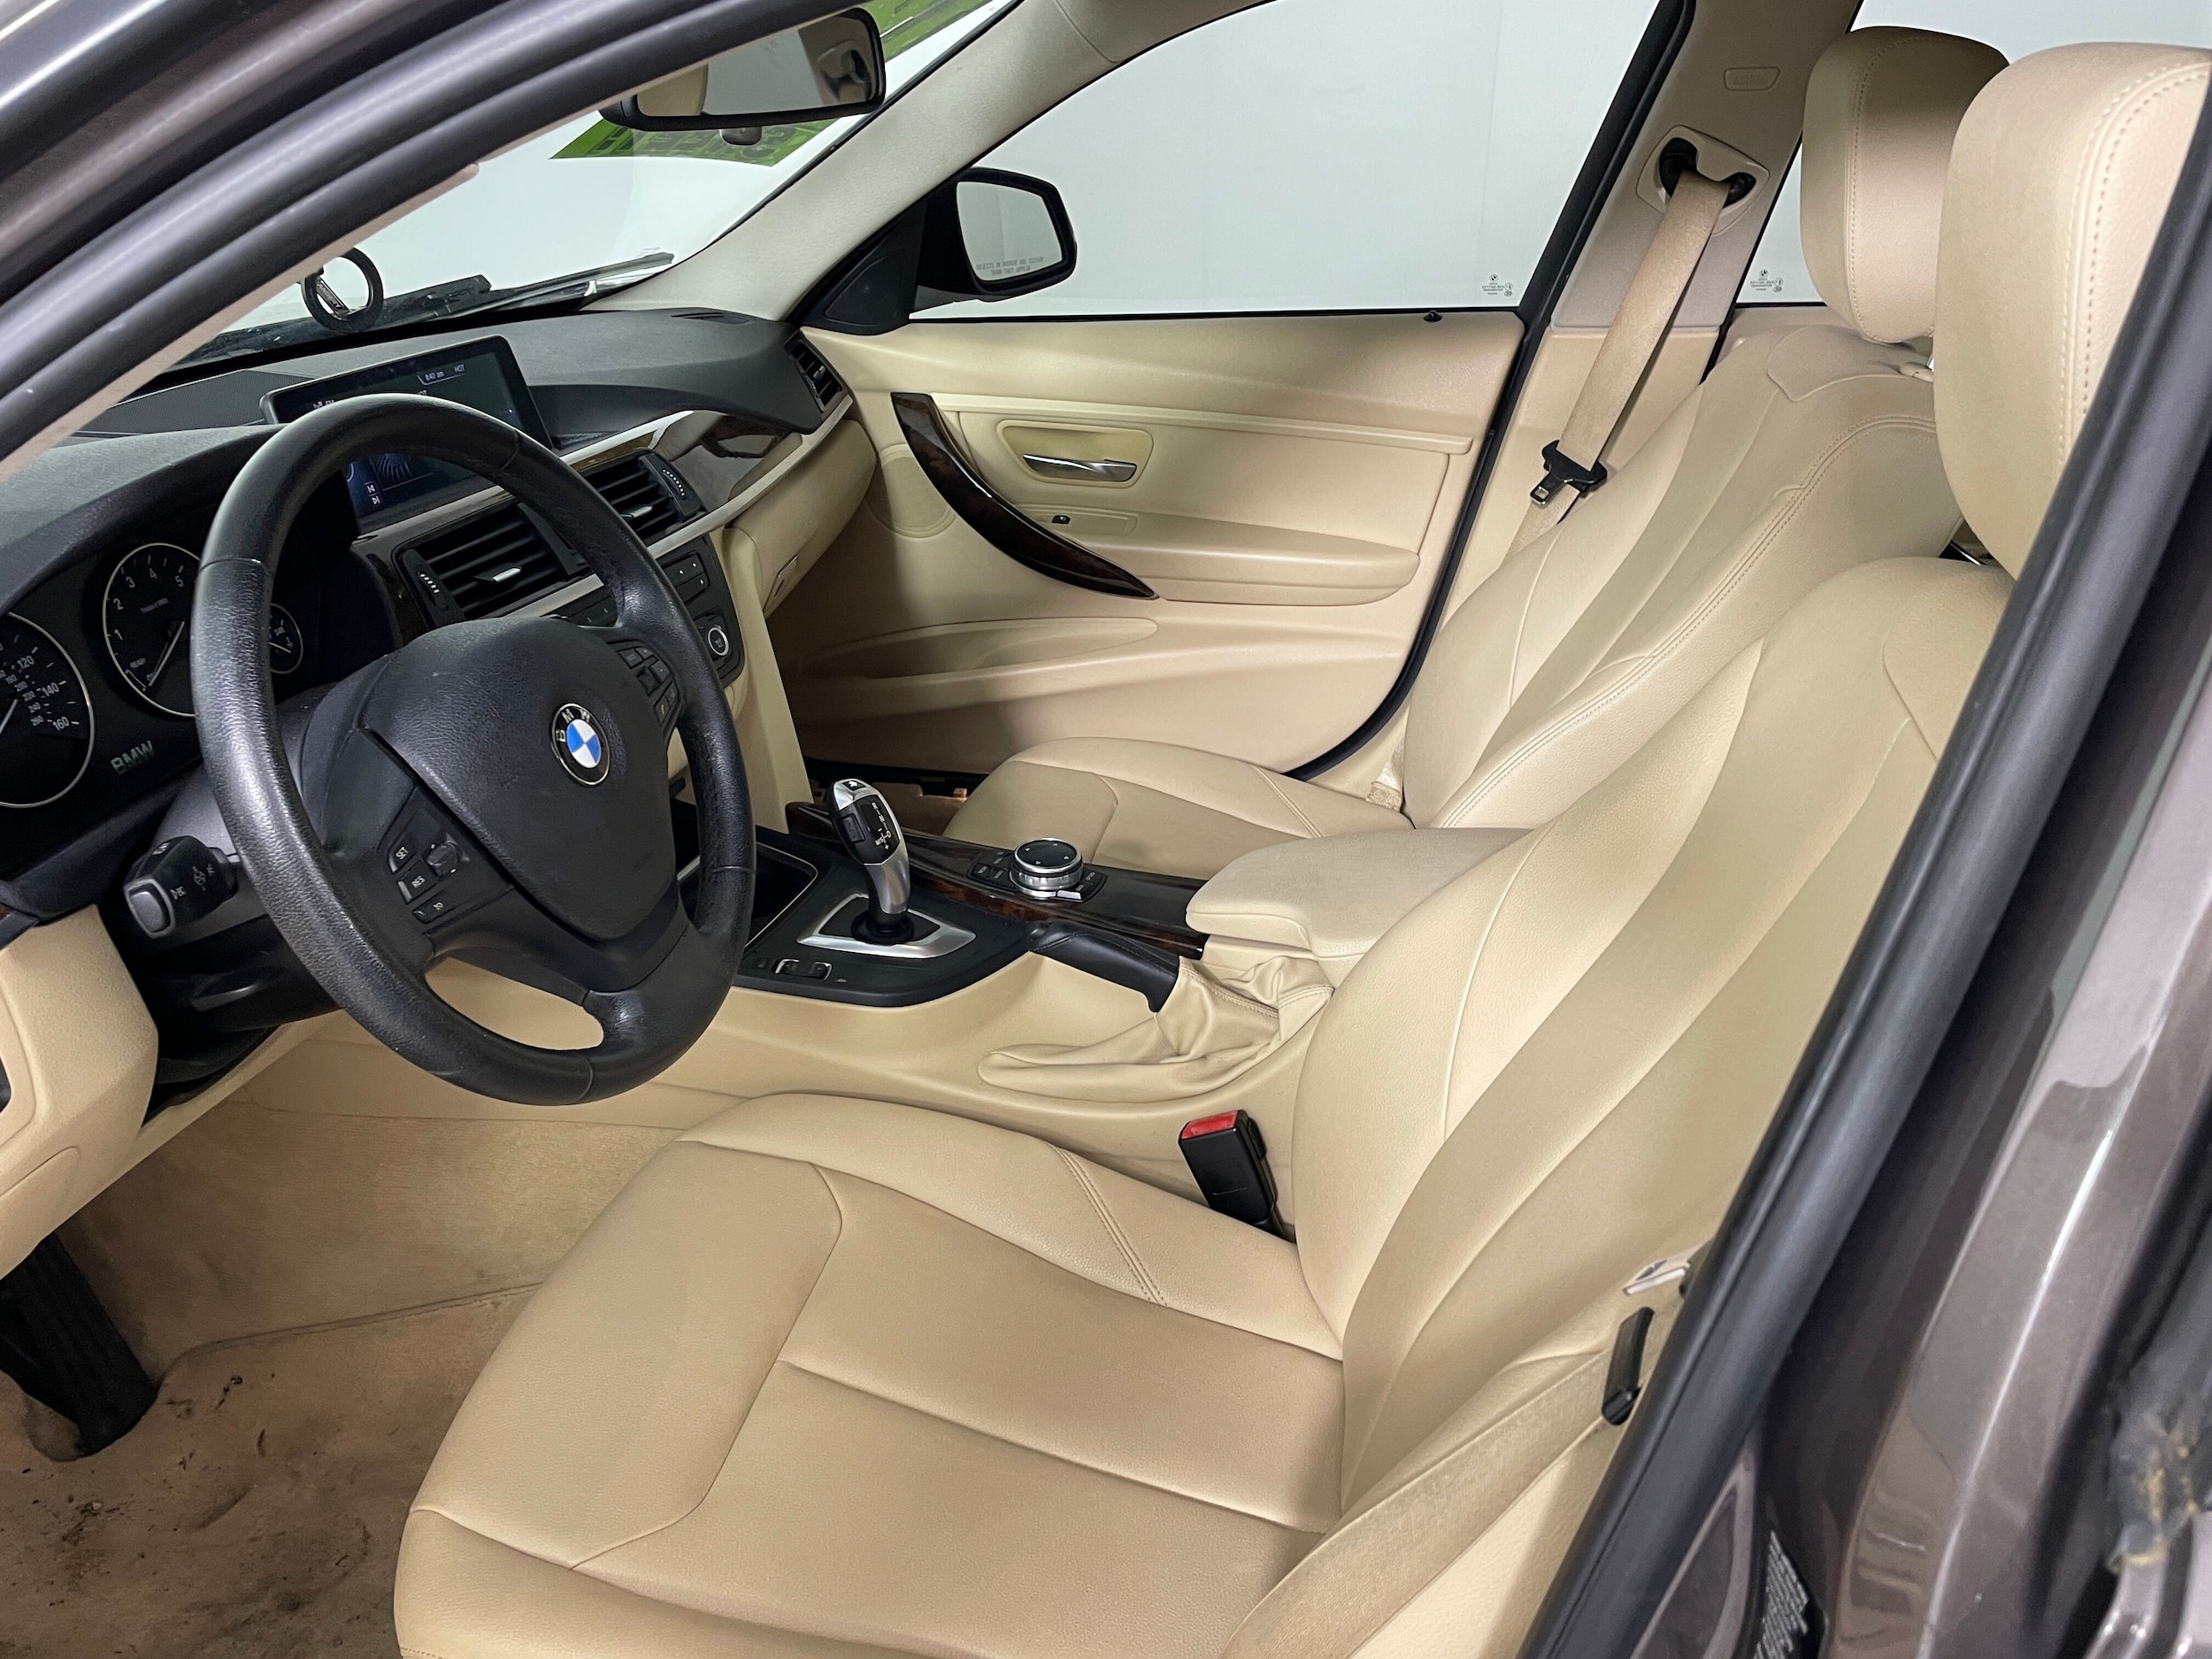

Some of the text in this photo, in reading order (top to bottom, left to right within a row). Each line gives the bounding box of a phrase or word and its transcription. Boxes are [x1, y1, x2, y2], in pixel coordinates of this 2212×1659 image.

[149, 568, 157, 579] 4
[126, 577, 135, 588] 3
[175, 576, 184, 587] 5
[113, 598, 124, 611] 2
[114, 629, 123, 640] 1
[17, 656, 35, 669] 120
[42, 682, 59, 697] 140
[52, 716, 69, 731] 160
[556, 709, 590, 742] BMW
[111, 740, 155, 774] BMW
[396, 847, 409, 859] SET
